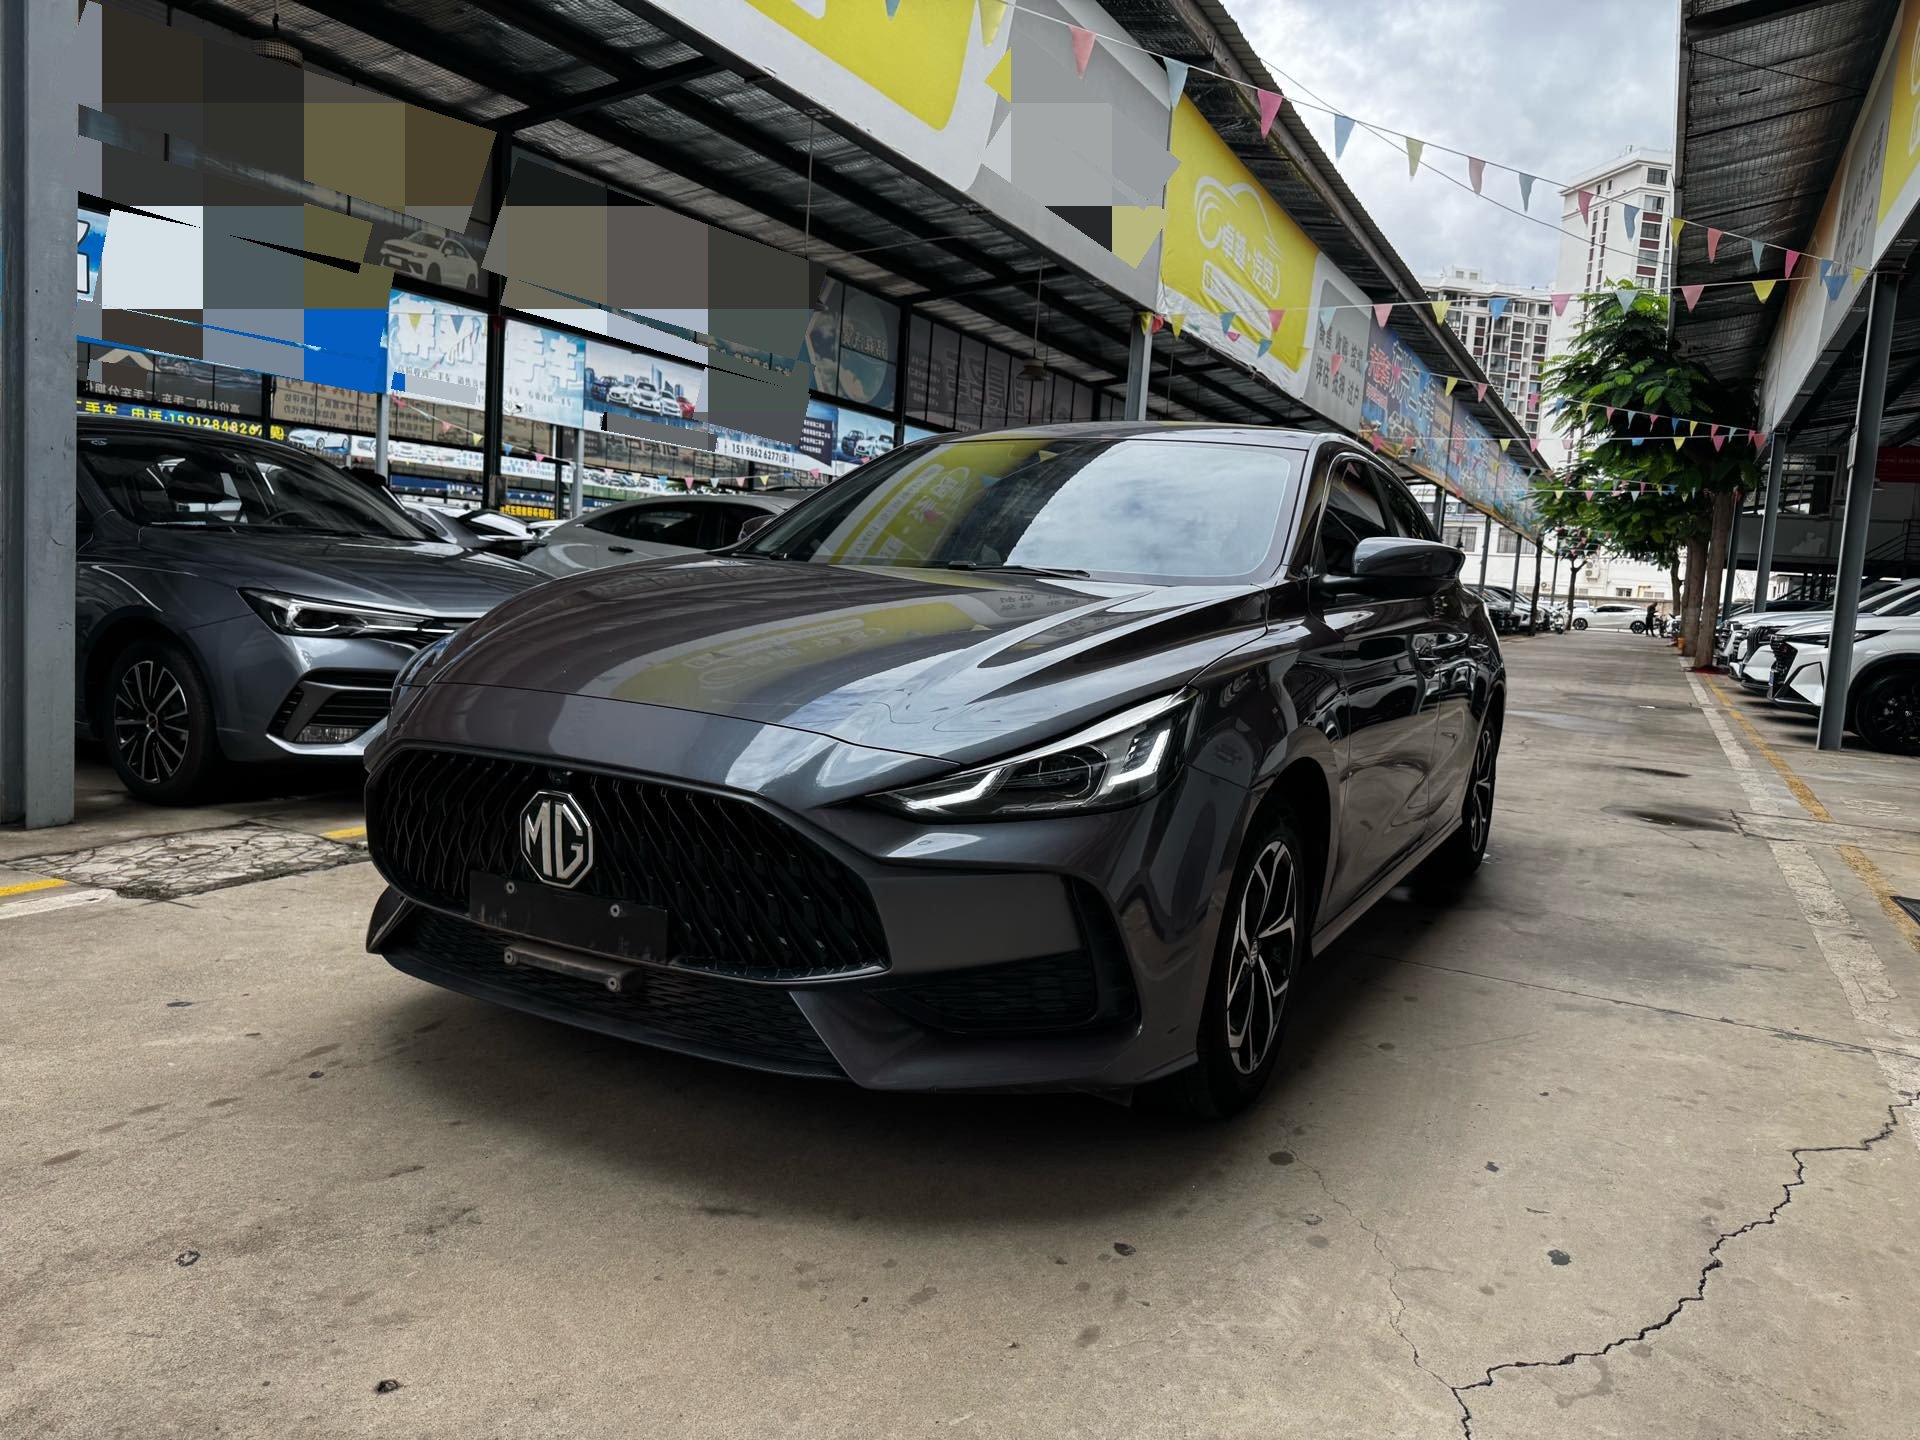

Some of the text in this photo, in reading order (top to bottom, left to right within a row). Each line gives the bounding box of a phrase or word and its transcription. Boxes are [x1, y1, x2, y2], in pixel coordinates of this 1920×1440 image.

[76, 400, 118, 415] 手车
[732, 443, 744, 454] 151
[525, 800, 584, 880] MG
